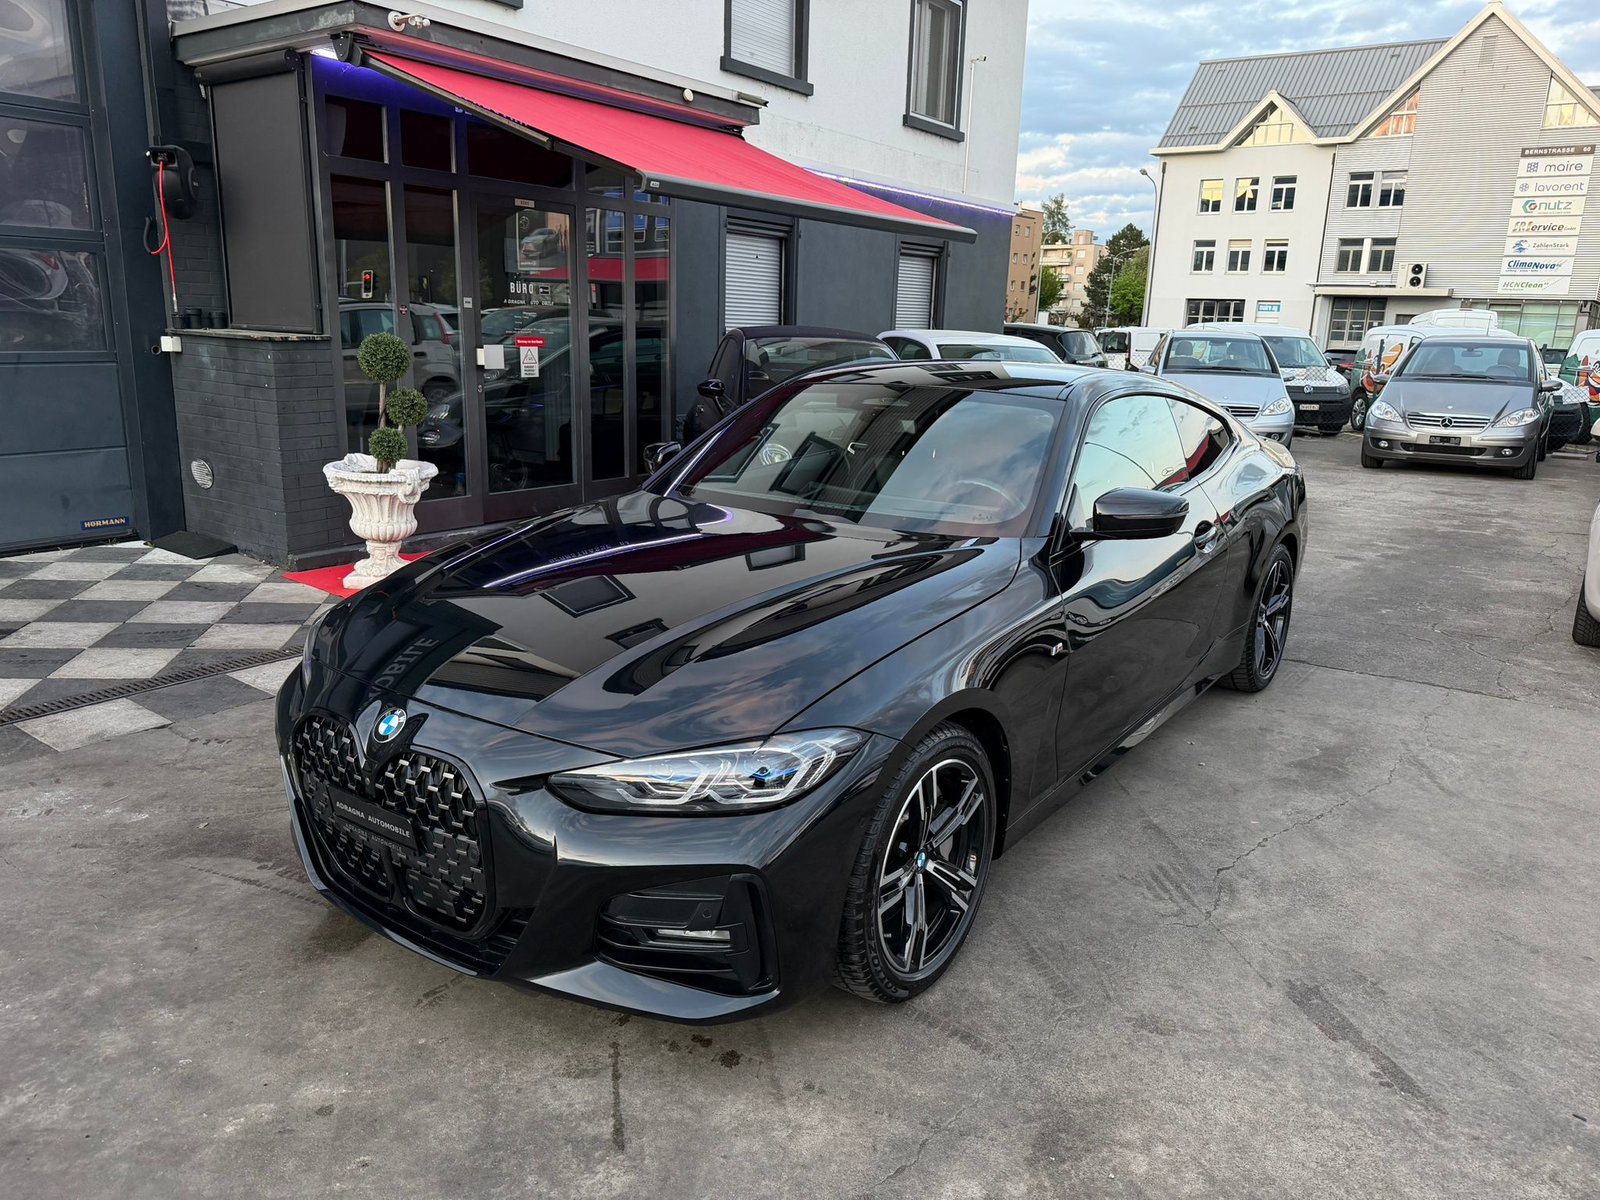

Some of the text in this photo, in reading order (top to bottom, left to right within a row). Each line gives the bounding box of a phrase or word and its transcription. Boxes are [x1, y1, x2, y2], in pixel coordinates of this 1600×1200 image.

[1525, 147, 1575, 155] BERNSTRASSE
[1544, 160, 1583, 172] maire
[1535, 182, 1584, 192] lavorent
[1538, 200, 1572, 210] nutz
[510, 281, 534, 294] BÜRO
[336, 801, 410, 838] ADRAGNA AUTOMOBILE
